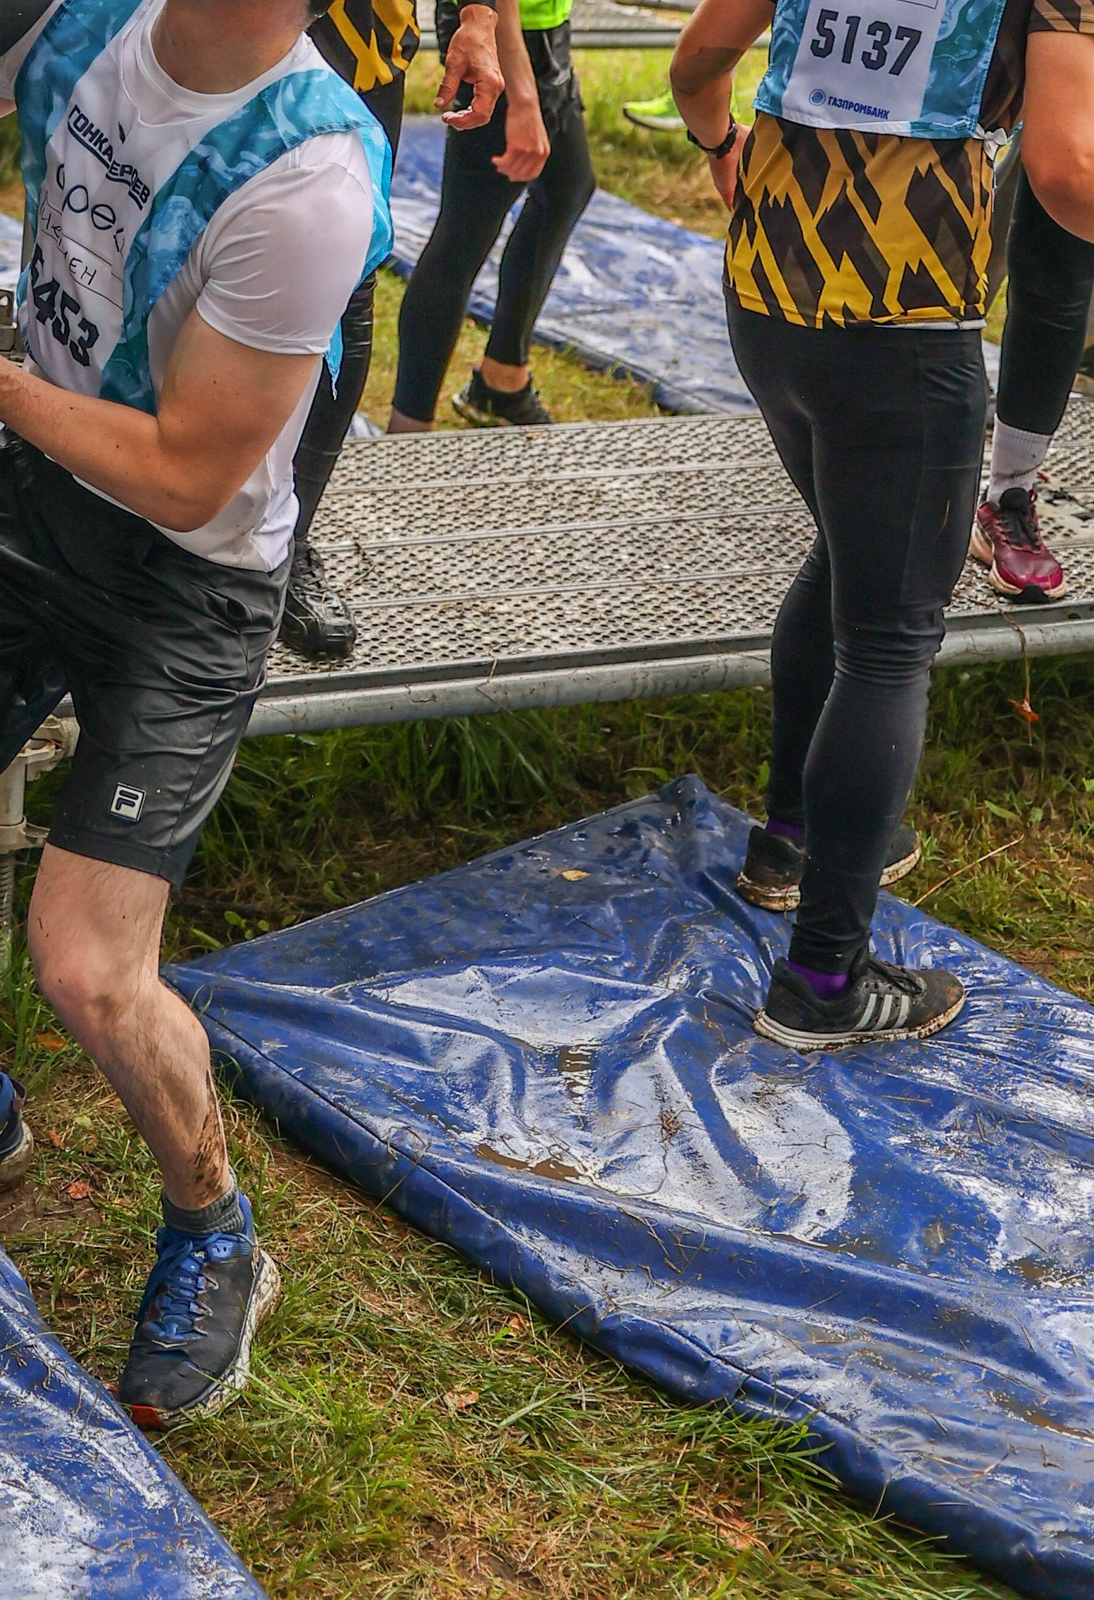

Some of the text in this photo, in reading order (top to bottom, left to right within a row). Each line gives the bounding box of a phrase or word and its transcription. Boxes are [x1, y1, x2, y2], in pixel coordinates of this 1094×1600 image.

[810, 8, 922, 76] 5137
[828, 96, 890, 120] ГАЗПРОМБАНК
[68, 104, 151, 205] ГОНКА ЕРОЕВ
